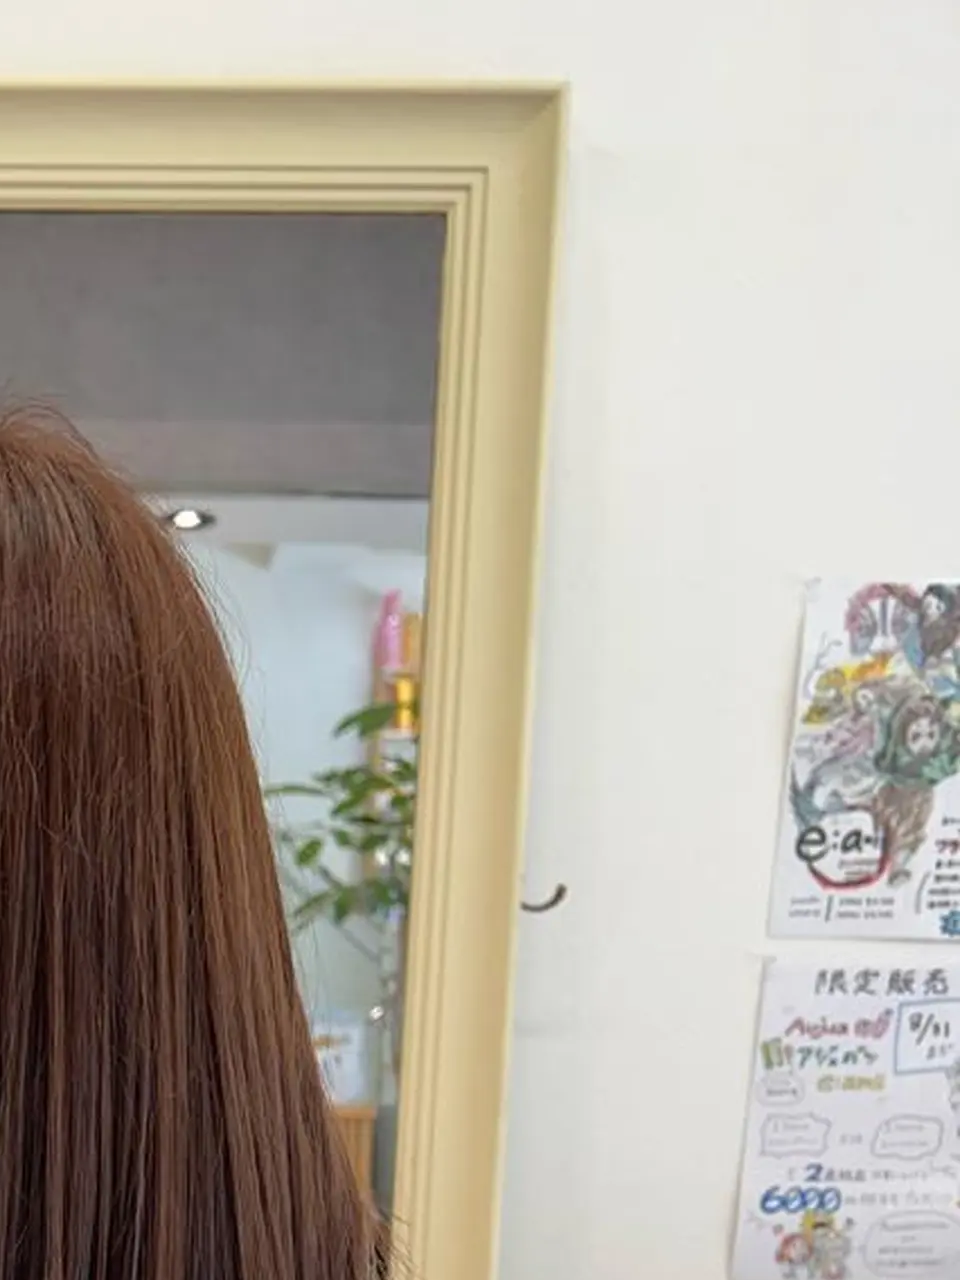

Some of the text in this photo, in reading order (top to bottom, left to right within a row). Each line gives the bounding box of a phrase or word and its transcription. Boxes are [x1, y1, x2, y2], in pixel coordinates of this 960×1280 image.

[814, 968, 950, 994] 限定販売
[760, 1186, 841, 1213] 6000
